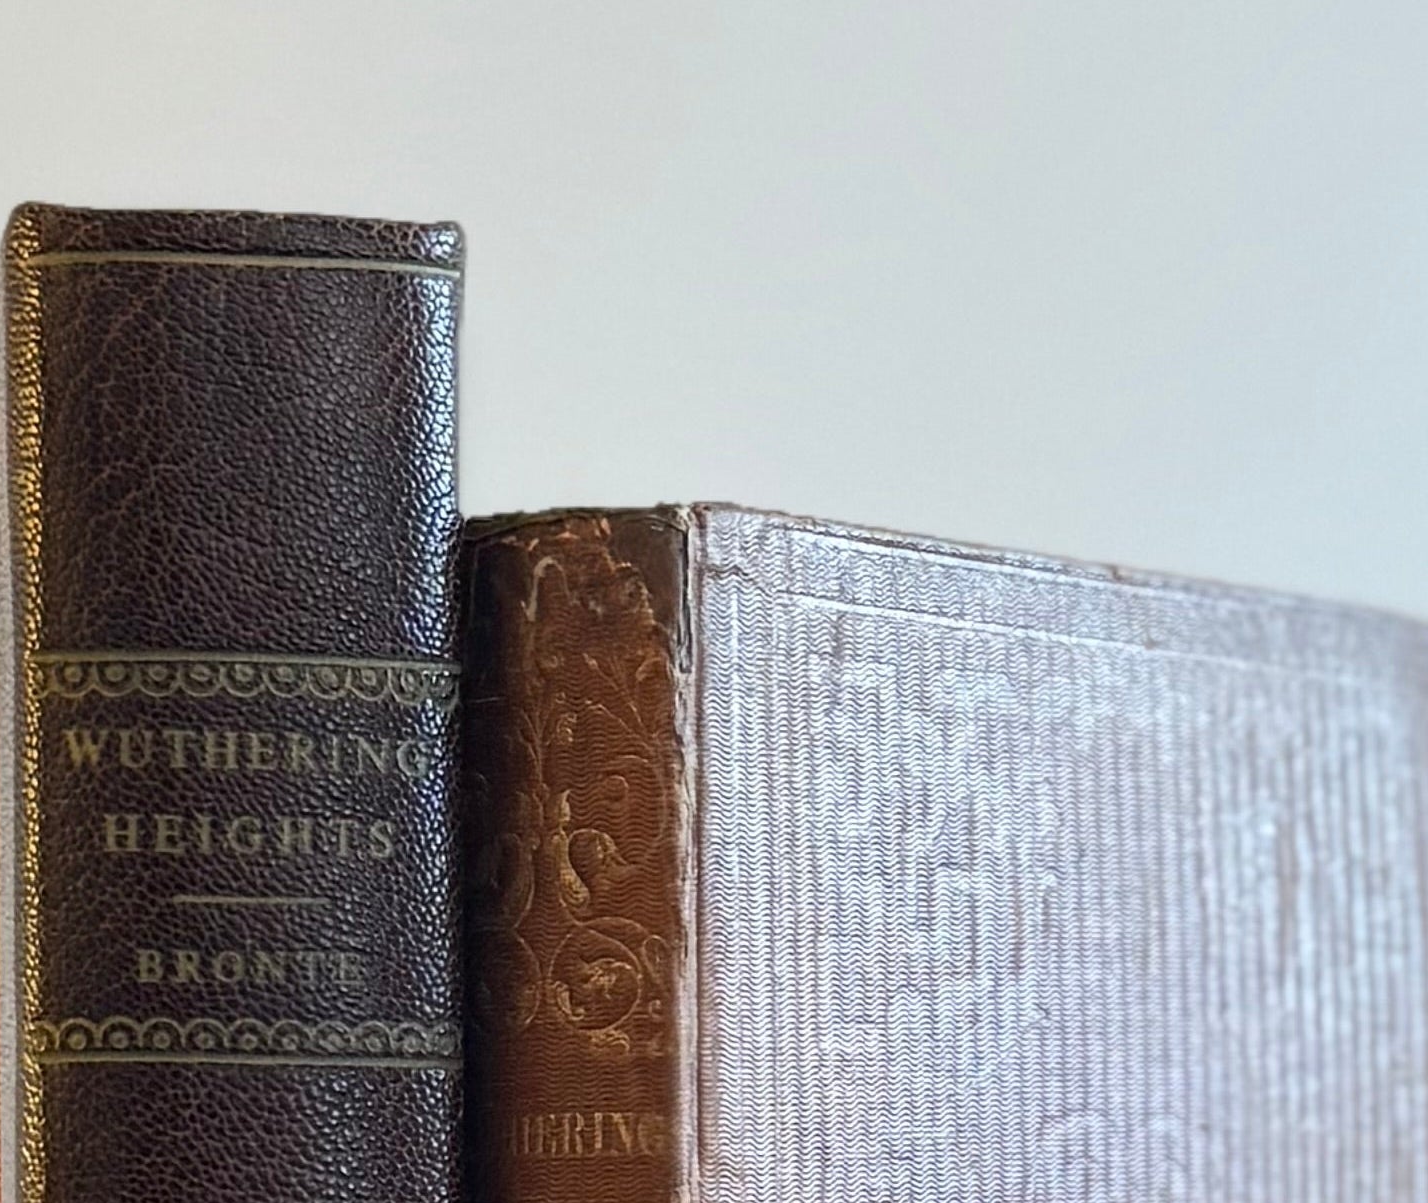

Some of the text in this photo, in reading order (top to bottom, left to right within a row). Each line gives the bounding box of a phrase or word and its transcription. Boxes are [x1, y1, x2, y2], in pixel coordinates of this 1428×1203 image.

[64, 726, 438, 778] WUTHERING
[102, 813, 396, 858] HEIGHTS
[136, 949, 367, 985] BRONTE
[505, 1110, 666, 1157] HERING
